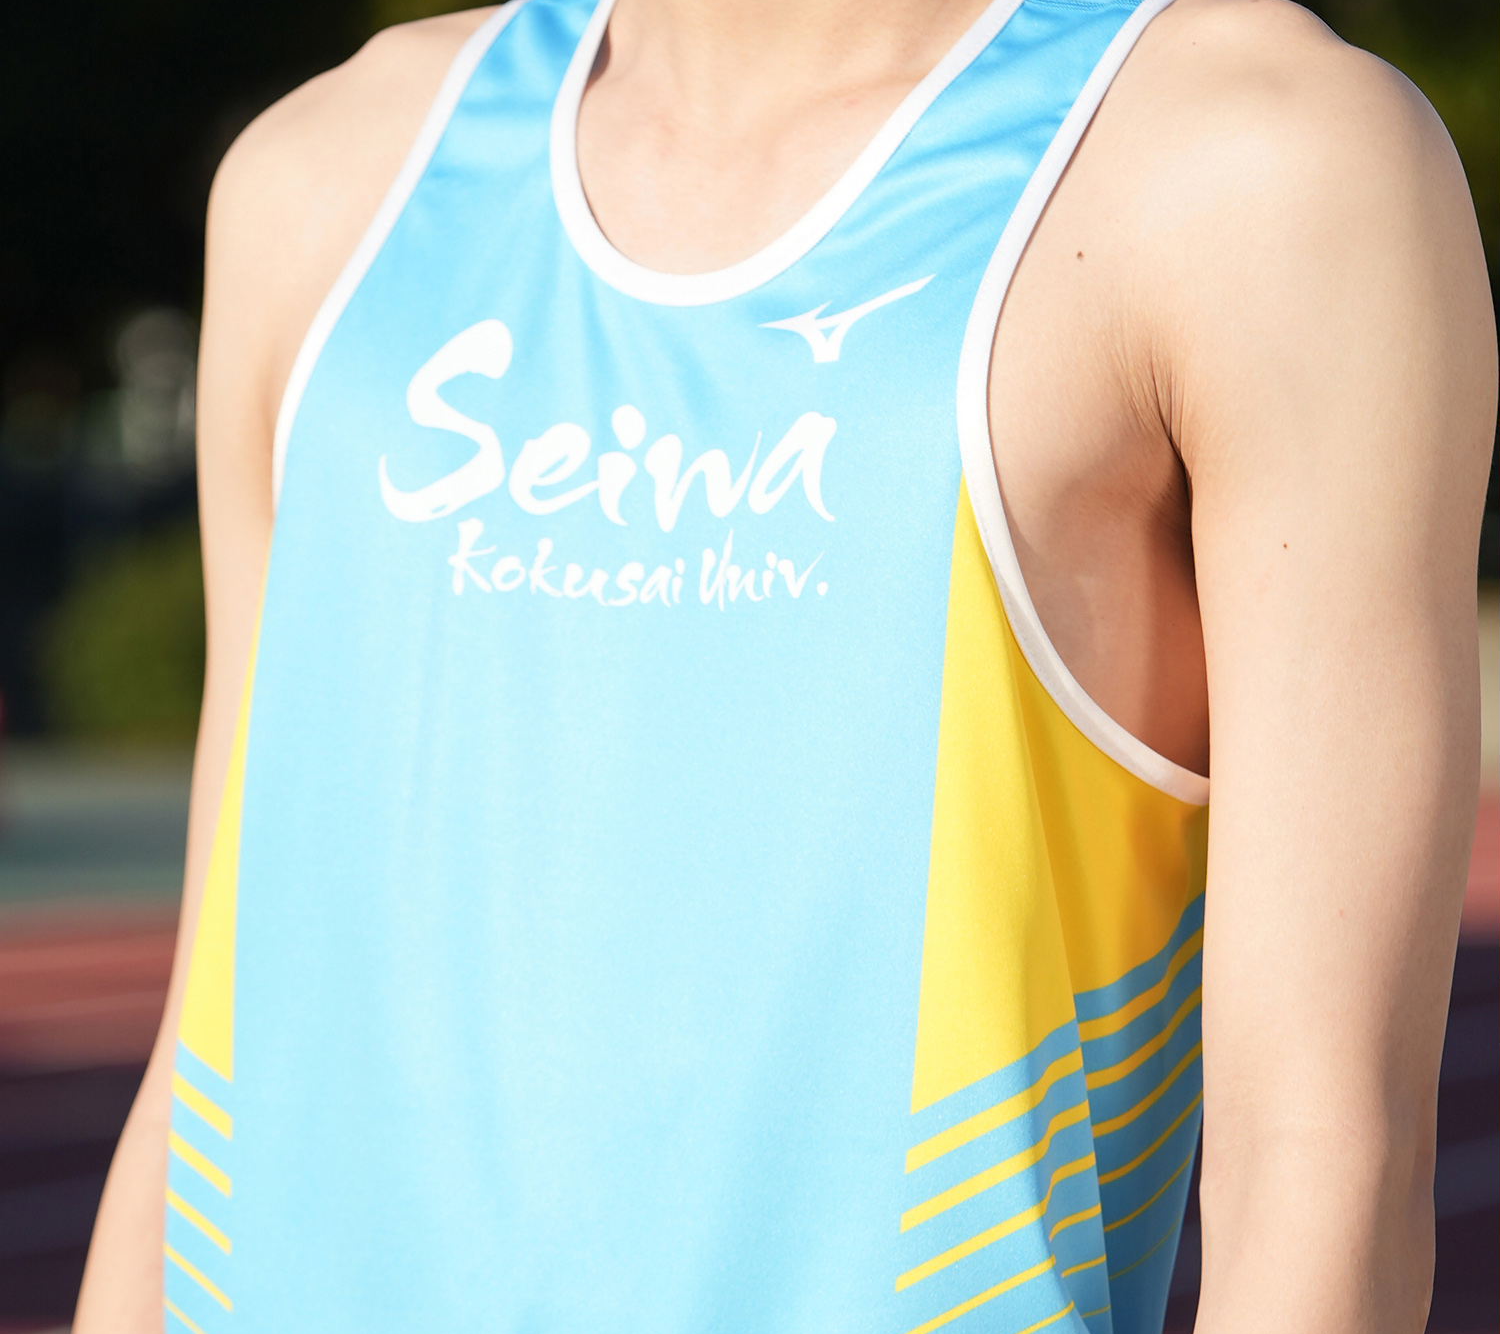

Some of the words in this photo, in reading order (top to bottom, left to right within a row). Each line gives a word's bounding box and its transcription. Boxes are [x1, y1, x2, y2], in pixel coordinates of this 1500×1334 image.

[377, 317, 838, 533] Seiwa
[447, 517, 686, 608] Kokusai
[698, 527, 825, 613] Univ.
